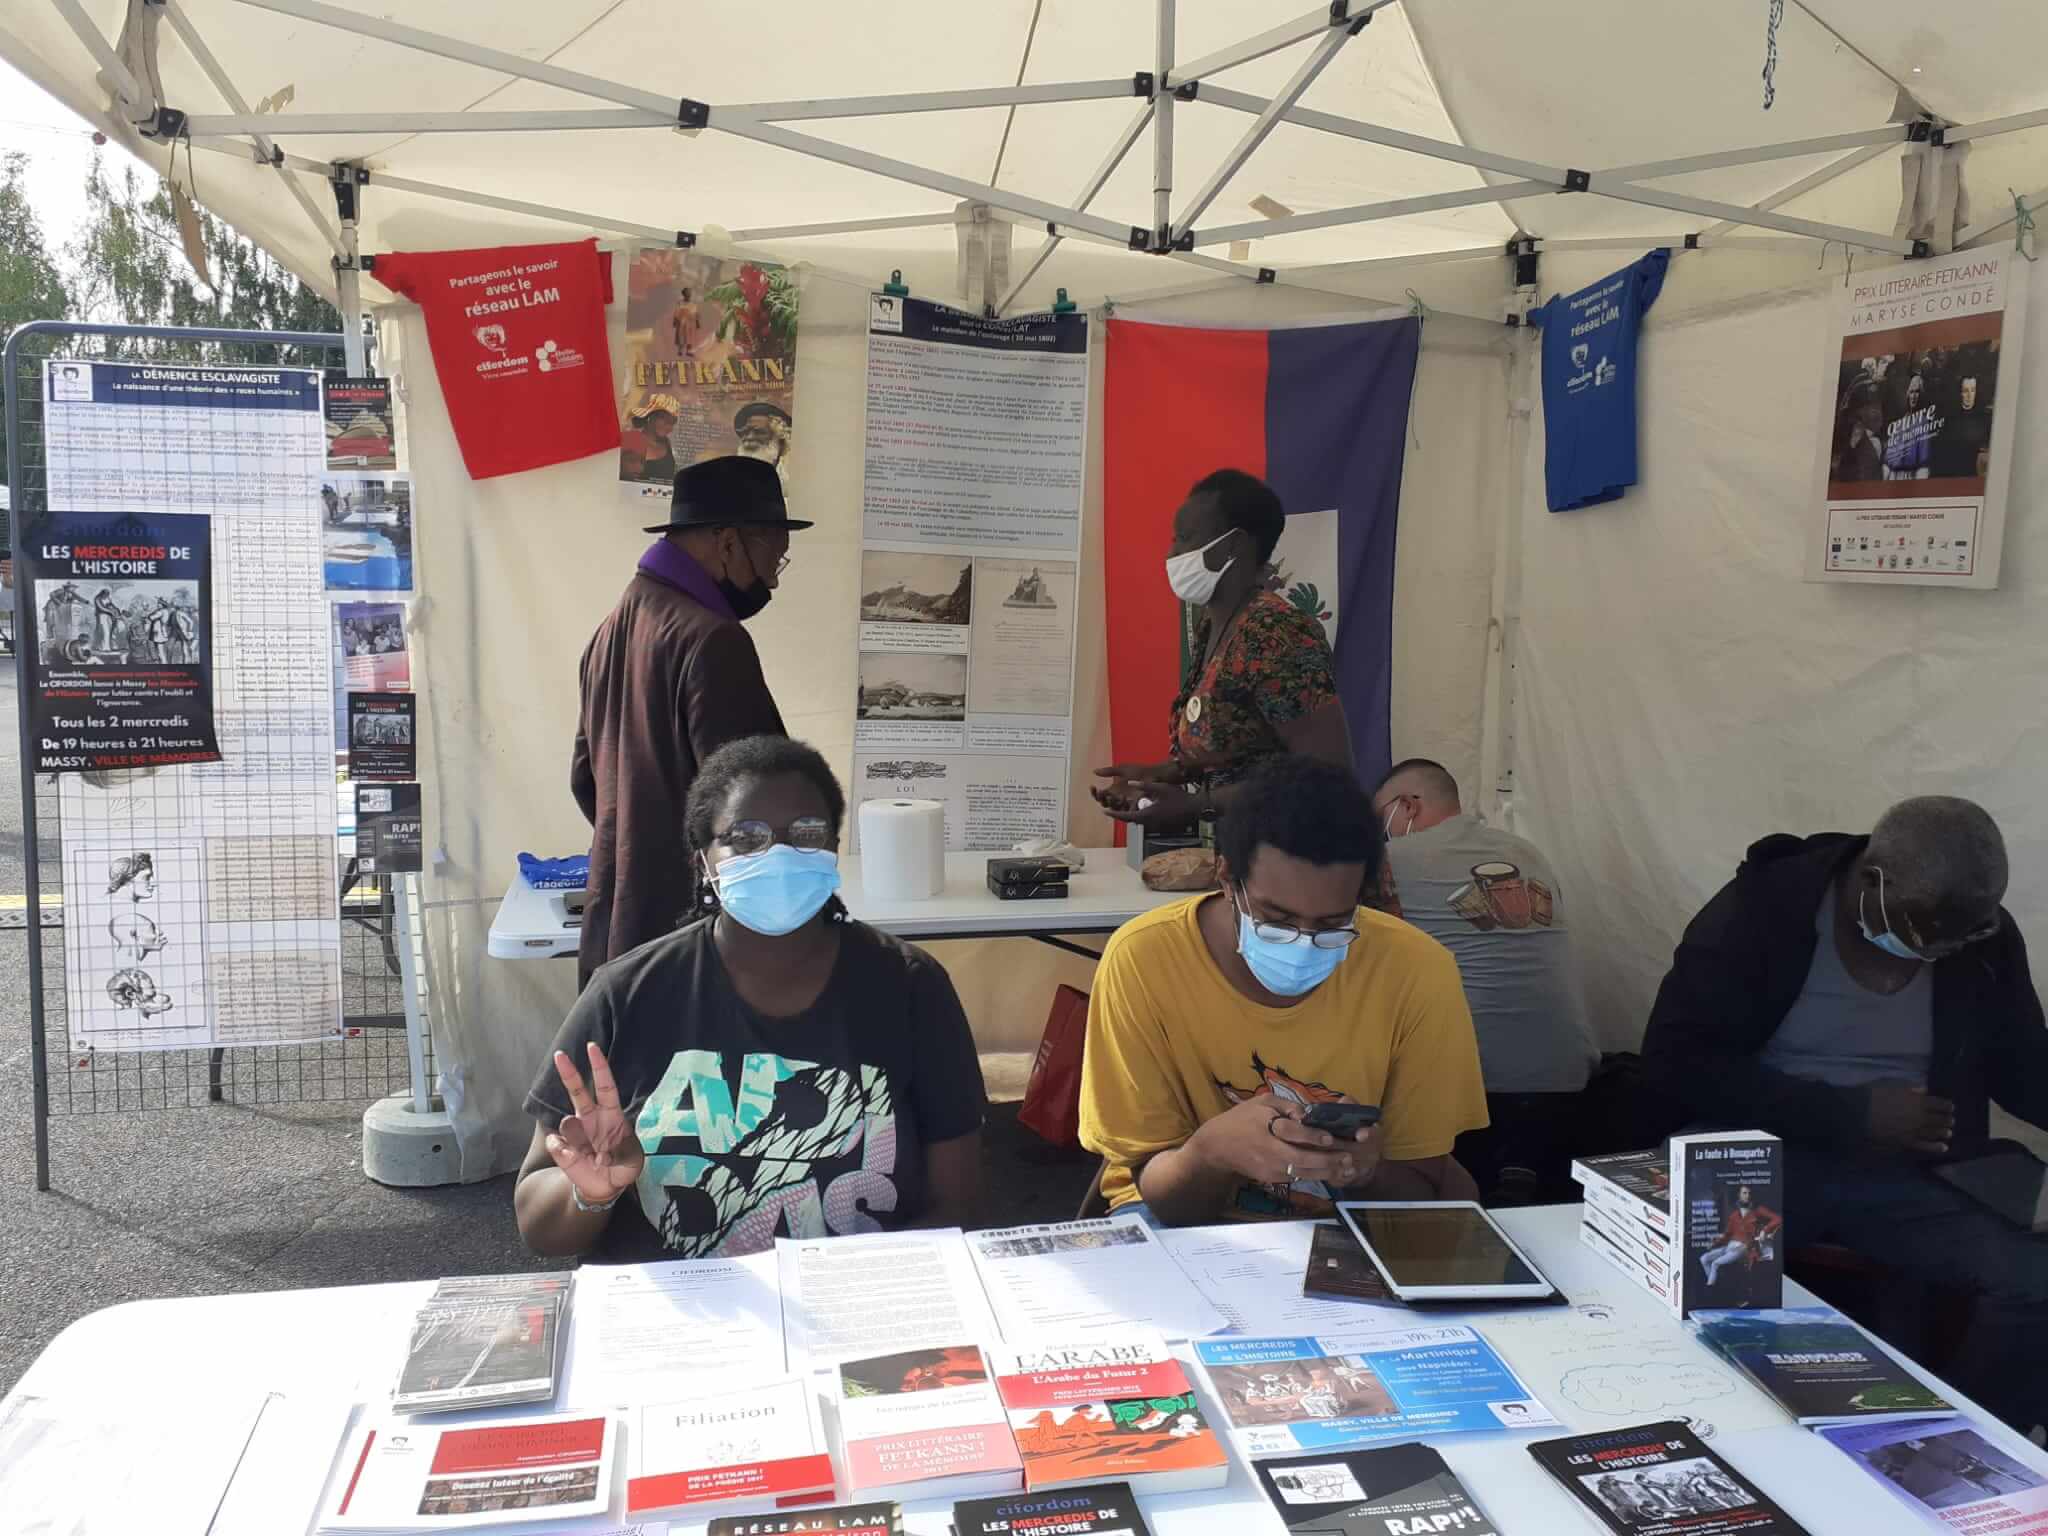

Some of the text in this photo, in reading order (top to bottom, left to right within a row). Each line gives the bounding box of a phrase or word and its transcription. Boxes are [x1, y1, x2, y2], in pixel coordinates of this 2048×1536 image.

[448, 259, 559, 289] Partageons le savoir
[485, 278, 532, 297] avec le
[464, 287, 561, 318] réseau LAM
[1850, 303, 1917, 327] MARYSE
[1570, 317, 1600, 337] réseau
[143, 368, 200, 382] DÉMENCE
[201, 371, 281, 385] ESCLAVAGISTE
[42, 545, 191, 560] LES MERCREDIS DE
[71, 561, 158, 574] L'HISTOIRE
[52, 714, 189, 728] Tous les 2 mercredis
[42, 737, 205, 750] De 19 heures à 21 heures
[95, 755, 129, 766] VILLE
[131, 753, 147, 765] DE
[1231, 1340, 1297, 1351] MERCREDIS
[1401, 1347, 1479, 1361] Martinique
[1032, 1366, 1150, 1386] L'Arabe du Futur 2
[675, 1406, 777, 1428] Filiation
[878, 1443, 978, 1464] FETKANN
[1567, 1440, 1687, 1465] LES MERCREDIS DE
[1598, 1453, 1669, 1470] L'HISTOIRE
[687, 1475, 711, 1484] PRIX
[712, 1470, 757, 1482] FETKANN
[702, 1480, 714, 1489] LA
[996, 1497, 1092, 1516] cifordom
[734, 1520, 823, 1536] RÉSEAU
[839, 1515, 887, 1528] LAM
[982, 1508, 1119, 1532] LES MERCREDIS DE
[1012, 1521, 1093, 1536] L'HISTOIRE
[1383, 1505, 1481, 1536] RAP!!
